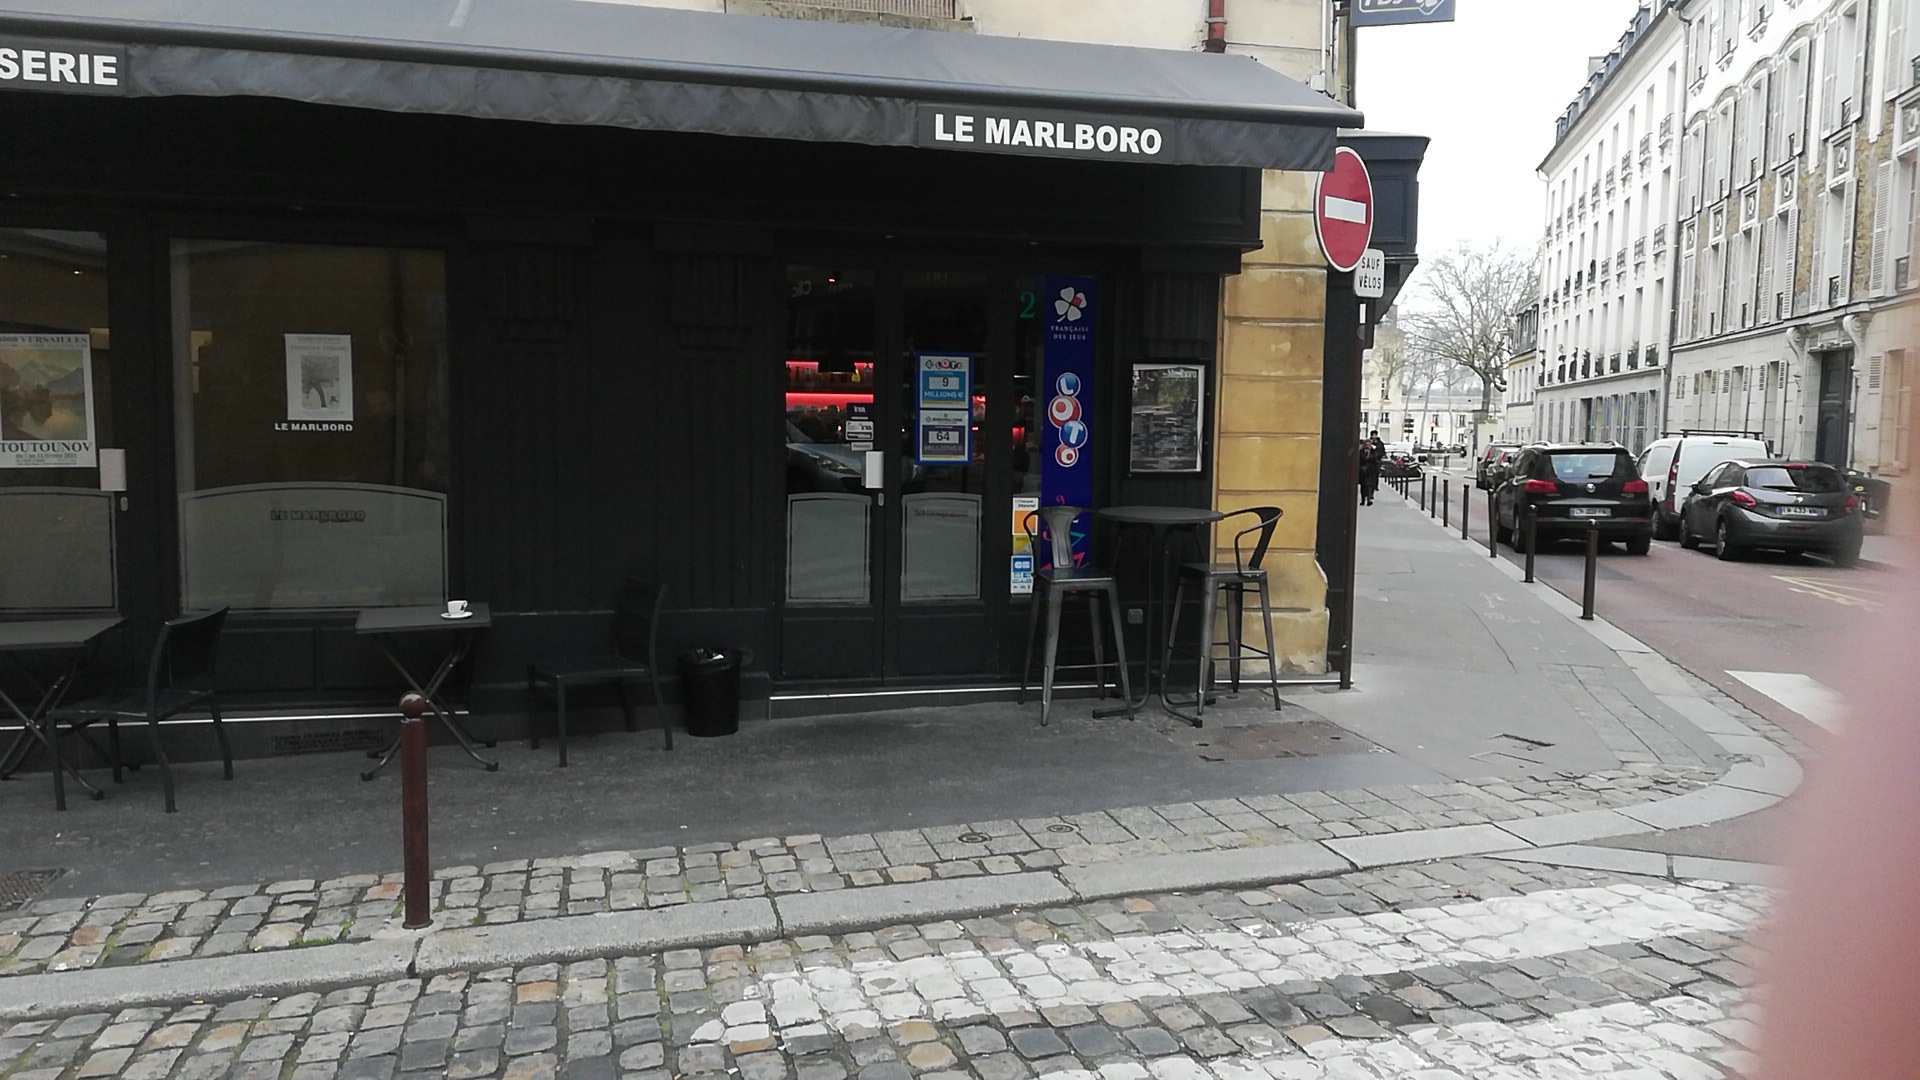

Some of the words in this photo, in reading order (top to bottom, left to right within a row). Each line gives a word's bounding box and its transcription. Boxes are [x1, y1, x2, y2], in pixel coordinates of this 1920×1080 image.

[0, 48, 118, 86] SERIE
[935, 113, 974, 142] LE
[985, 117, 1162, 155] MARLBORO
[1361, 256, 1380, 270] SAUF
[1359, 273, 1382, 289] VÉLOS
[1050, 325, 1089, 333] FRANÇAISE
[942, 376, 949, 387] 9
[274, 422, 288, 431] LE
[291, 423, 353, 432] MARLBORO
[936, 431, 950, 441] 64
[0, 441, 92, 453] TOUTOUNOV
